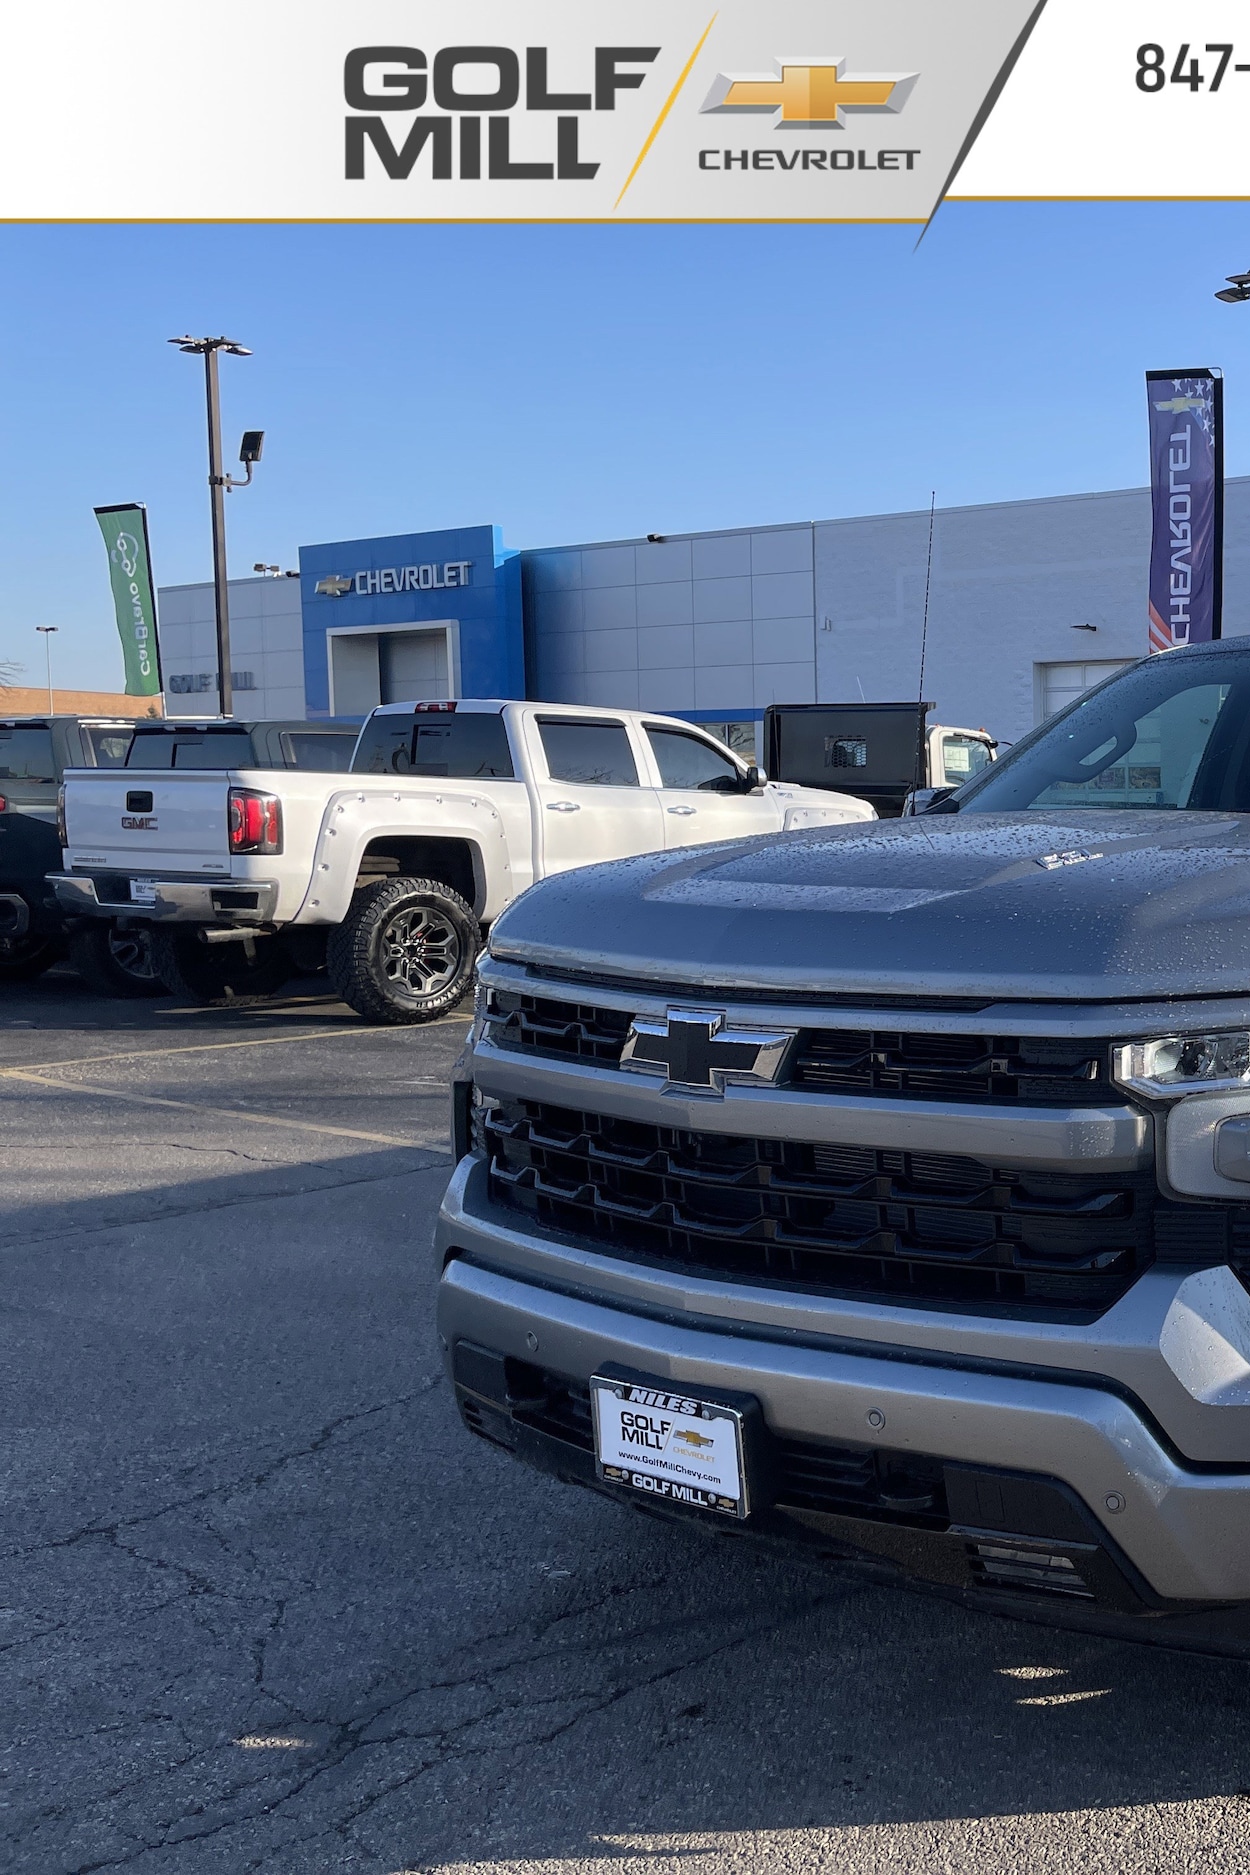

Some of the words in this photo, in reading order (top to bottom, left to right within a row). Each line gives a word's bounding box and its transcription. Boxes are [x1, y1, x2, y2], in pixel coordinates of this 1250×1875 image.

[355, 561, 471, 595] CHEVROLET
[121, 817, 158, 830] GMC
[629, 1388, 698, 1416] NILES
[620, 1411, 671, 1435] GOLF
[621, 1426, 663, 1450] MILL
[618, 1450, 721, 1485] www.GolfMillChevy.com
[672, 1446, 715, 1463] CHEVROLET
[632, 1473, 671, 1494] GOLF
[671, 1486, 708, 1506] MILL
